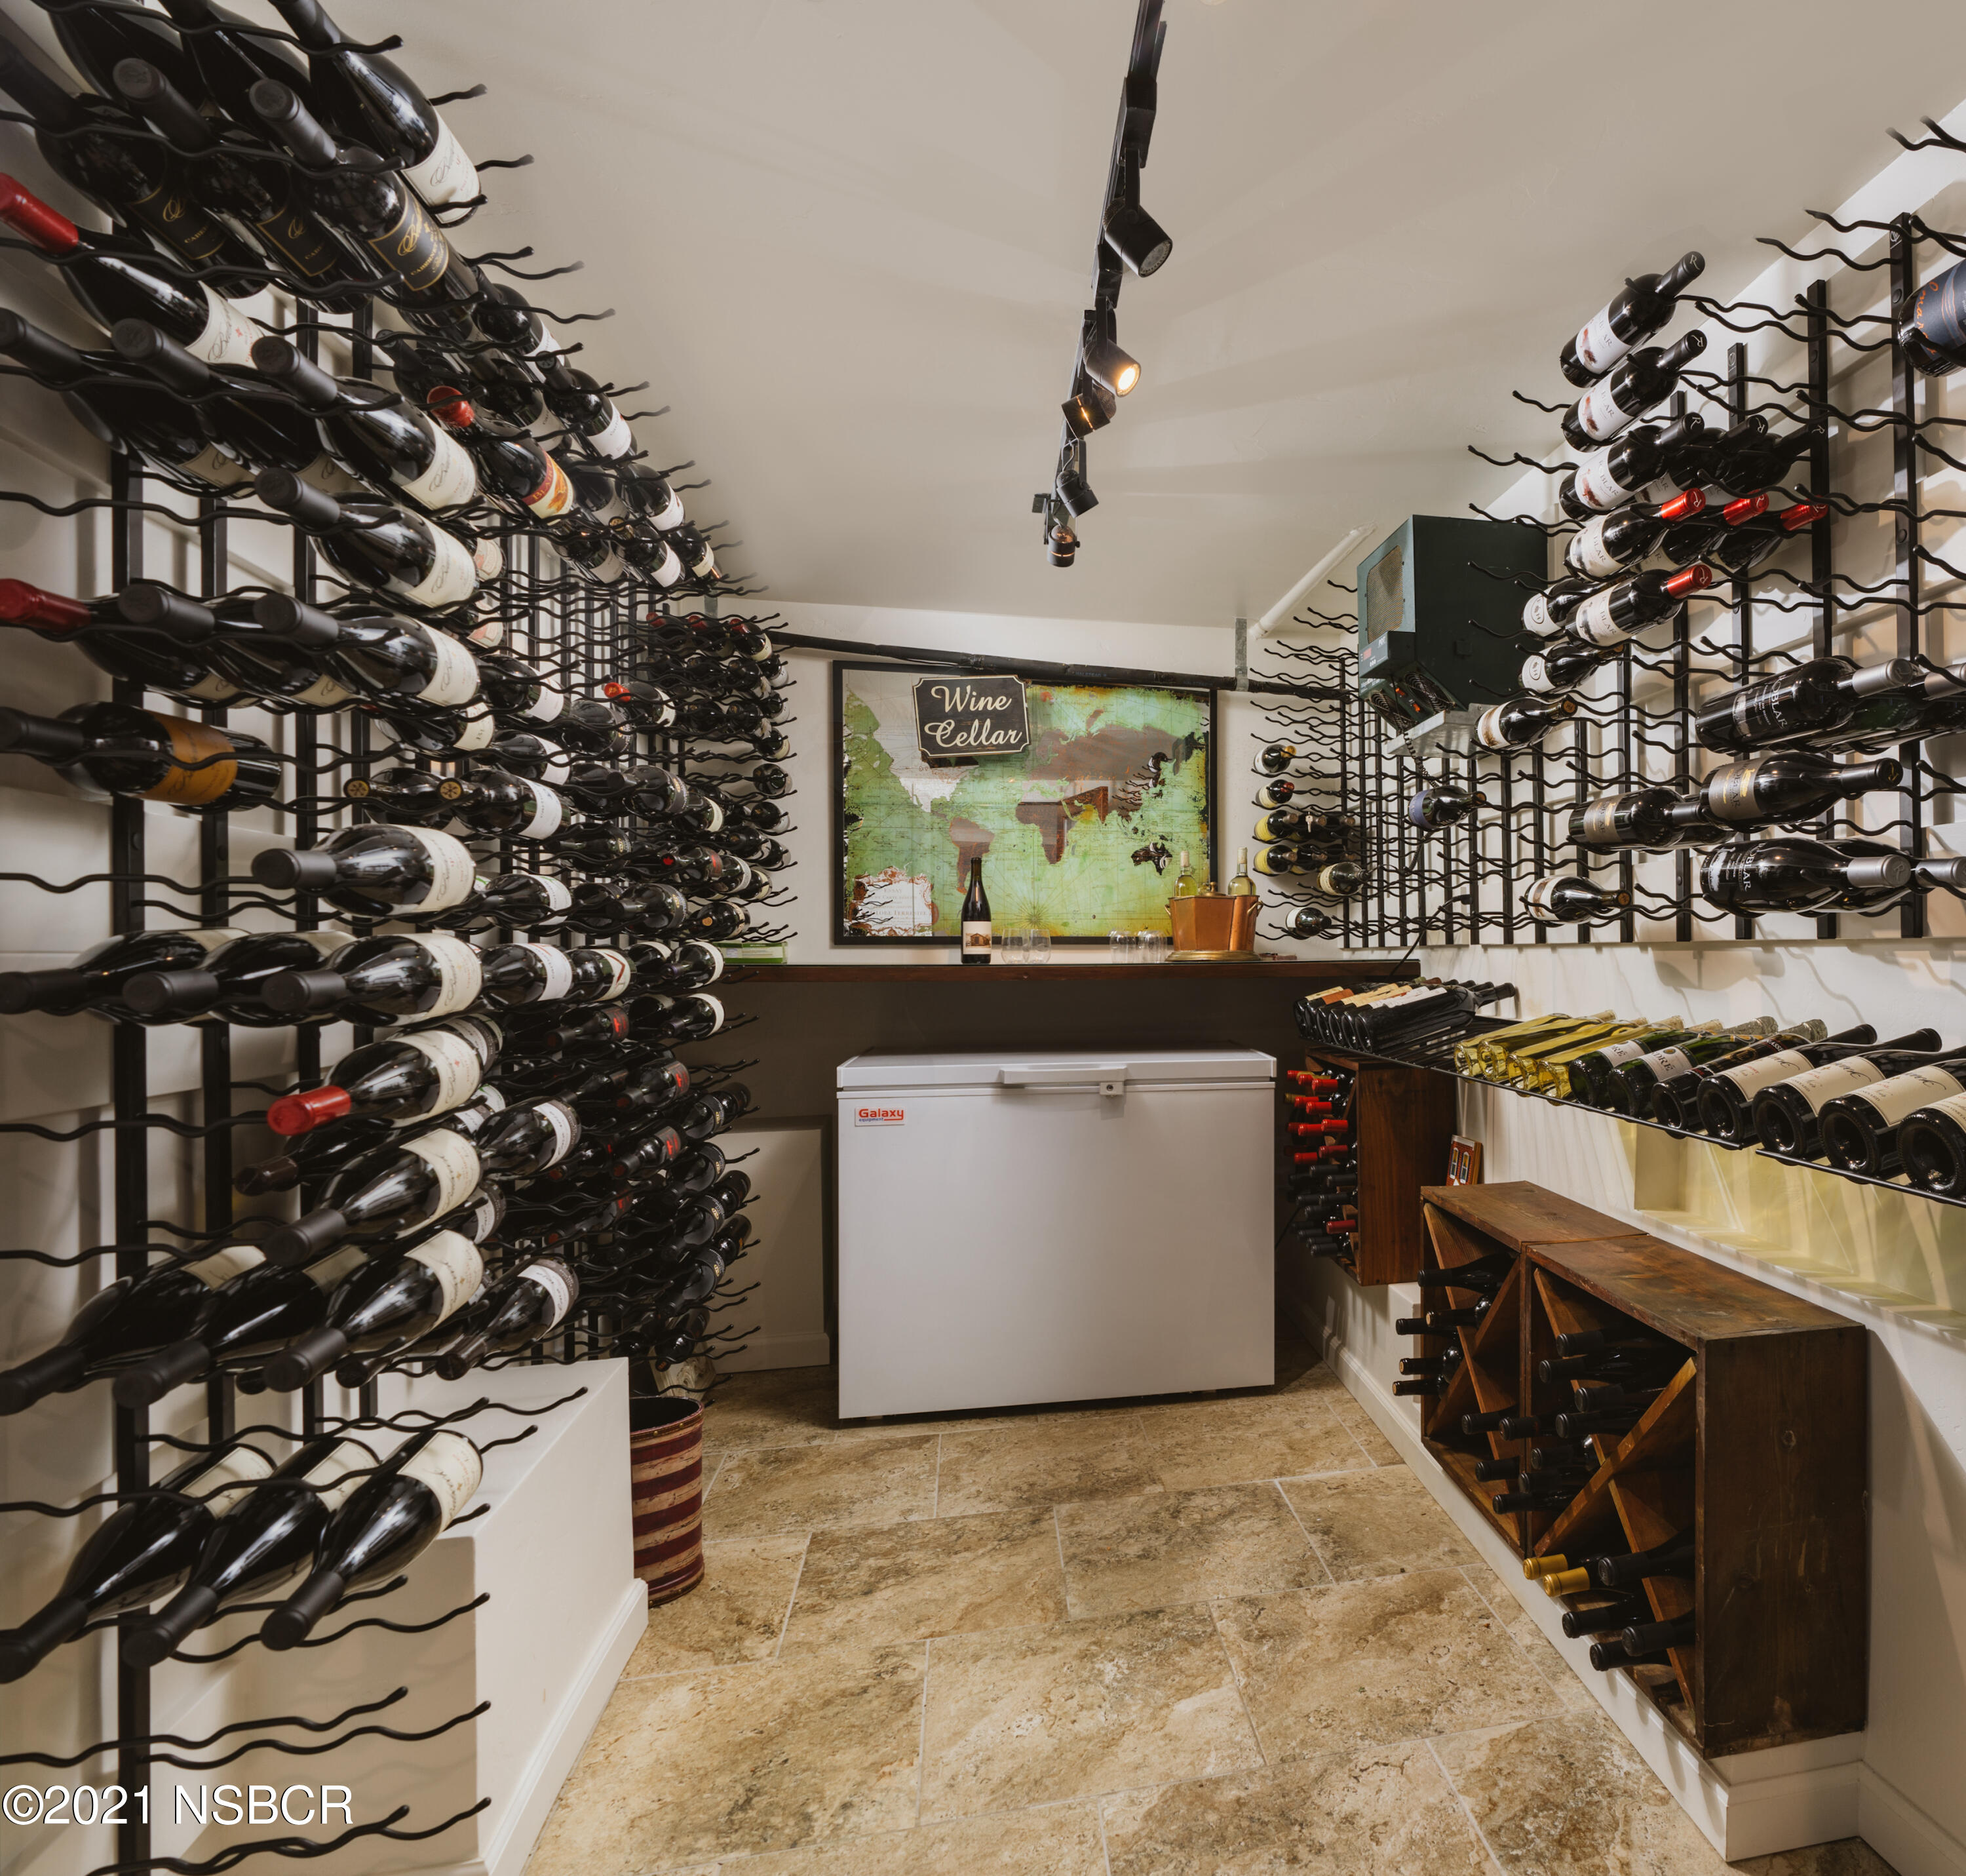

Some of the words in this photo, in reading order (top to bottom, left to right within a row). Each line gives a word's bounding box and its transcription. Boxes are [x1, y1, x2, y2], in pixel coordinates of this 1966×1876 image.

[931, 685, 1012, 713] Wine
[924, 718, 1022, 747] Cellar
[858, 1108, 904, 1121] Galaxy
